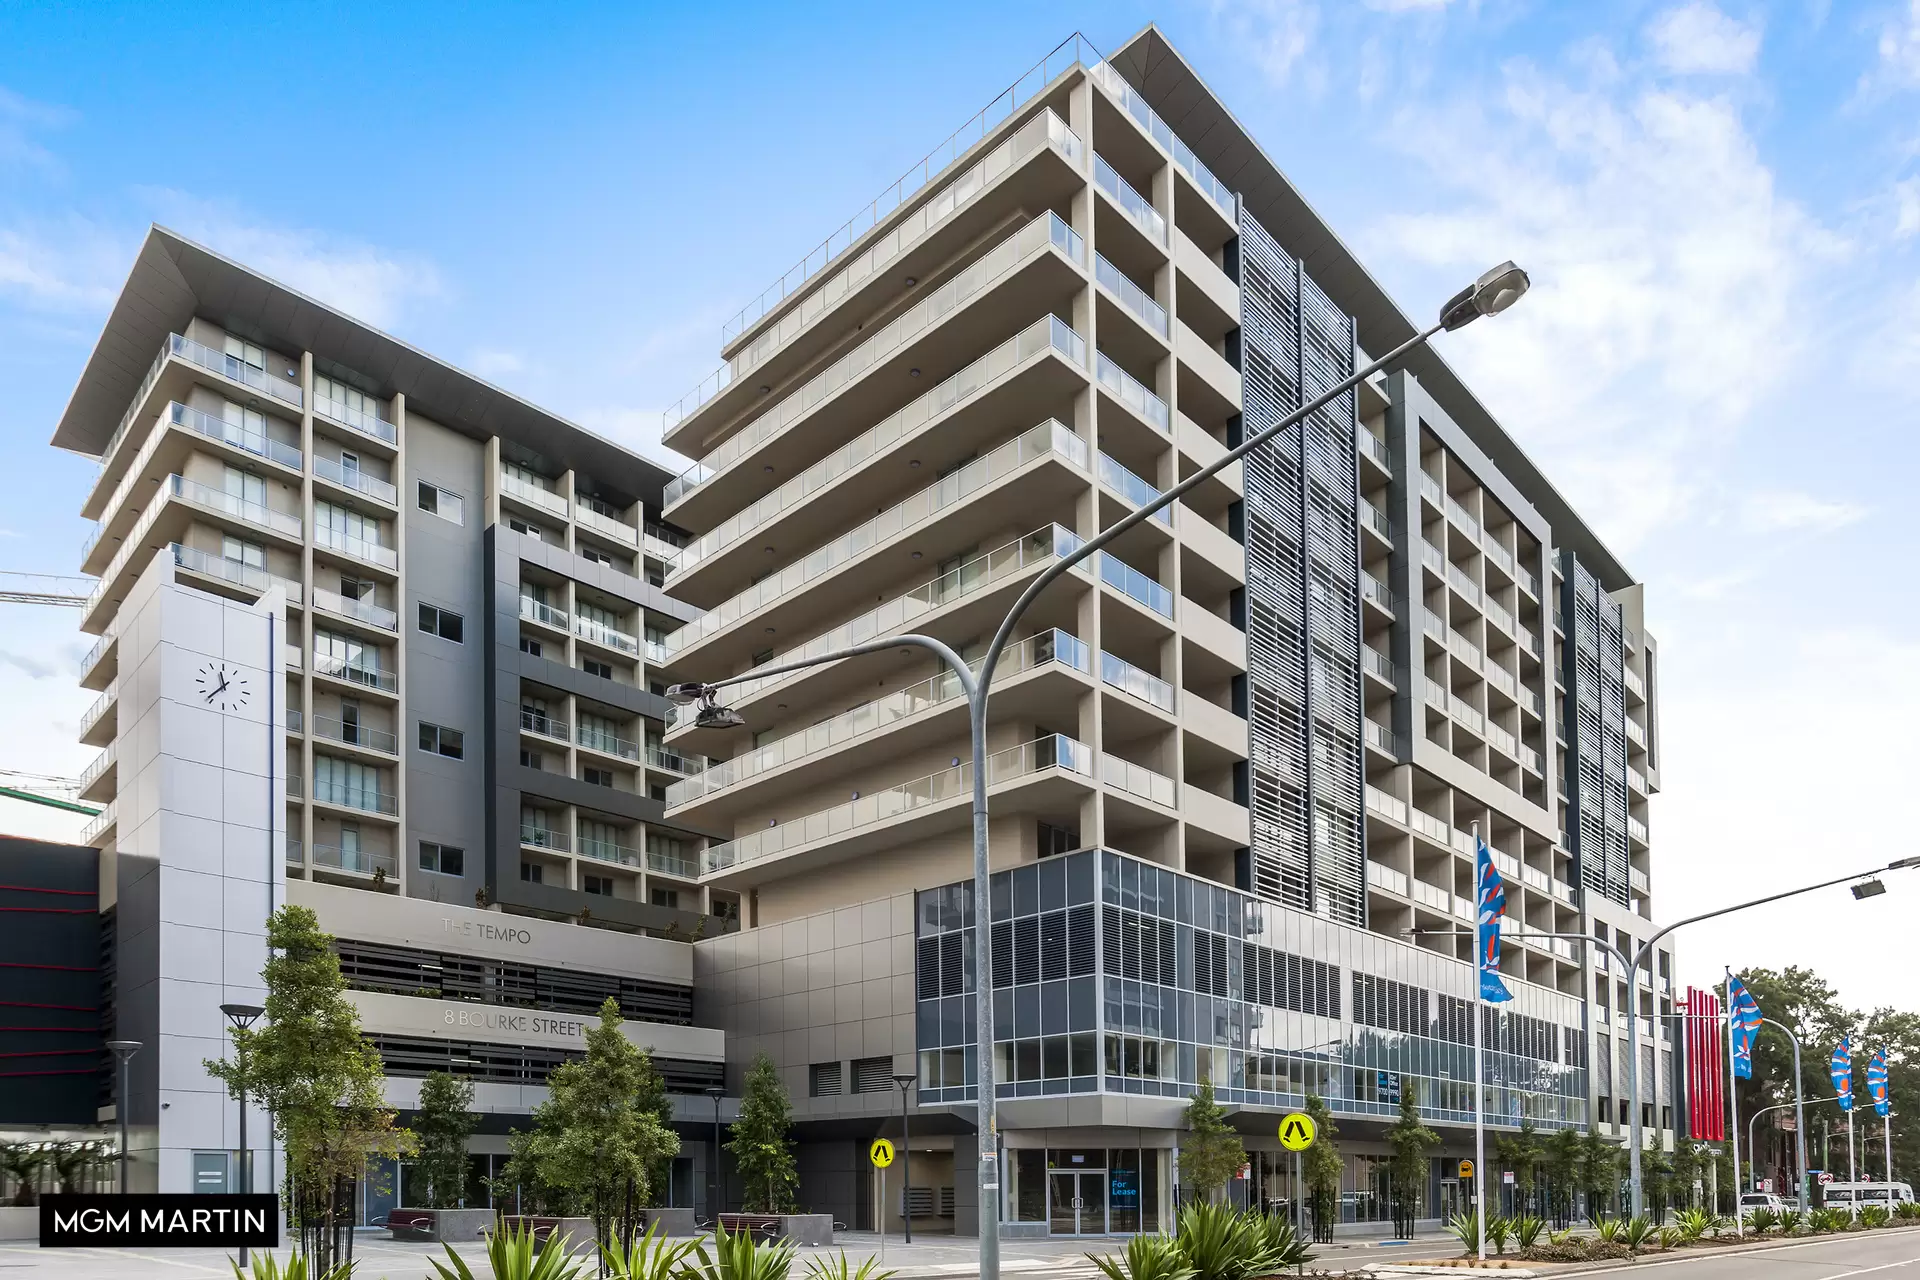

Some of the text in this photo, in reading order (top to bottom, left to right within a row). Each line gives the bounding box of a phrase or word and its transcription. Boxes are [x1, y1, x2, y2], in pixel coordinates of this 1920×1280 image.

[441, 917, 531, 944] THE TEMPO
[444, 1009, 585, 1037] 8 BOURKE STREET
[1112, 1180, 1127, 1188] For
[1112, 1187, 1137, 1195] Lease
